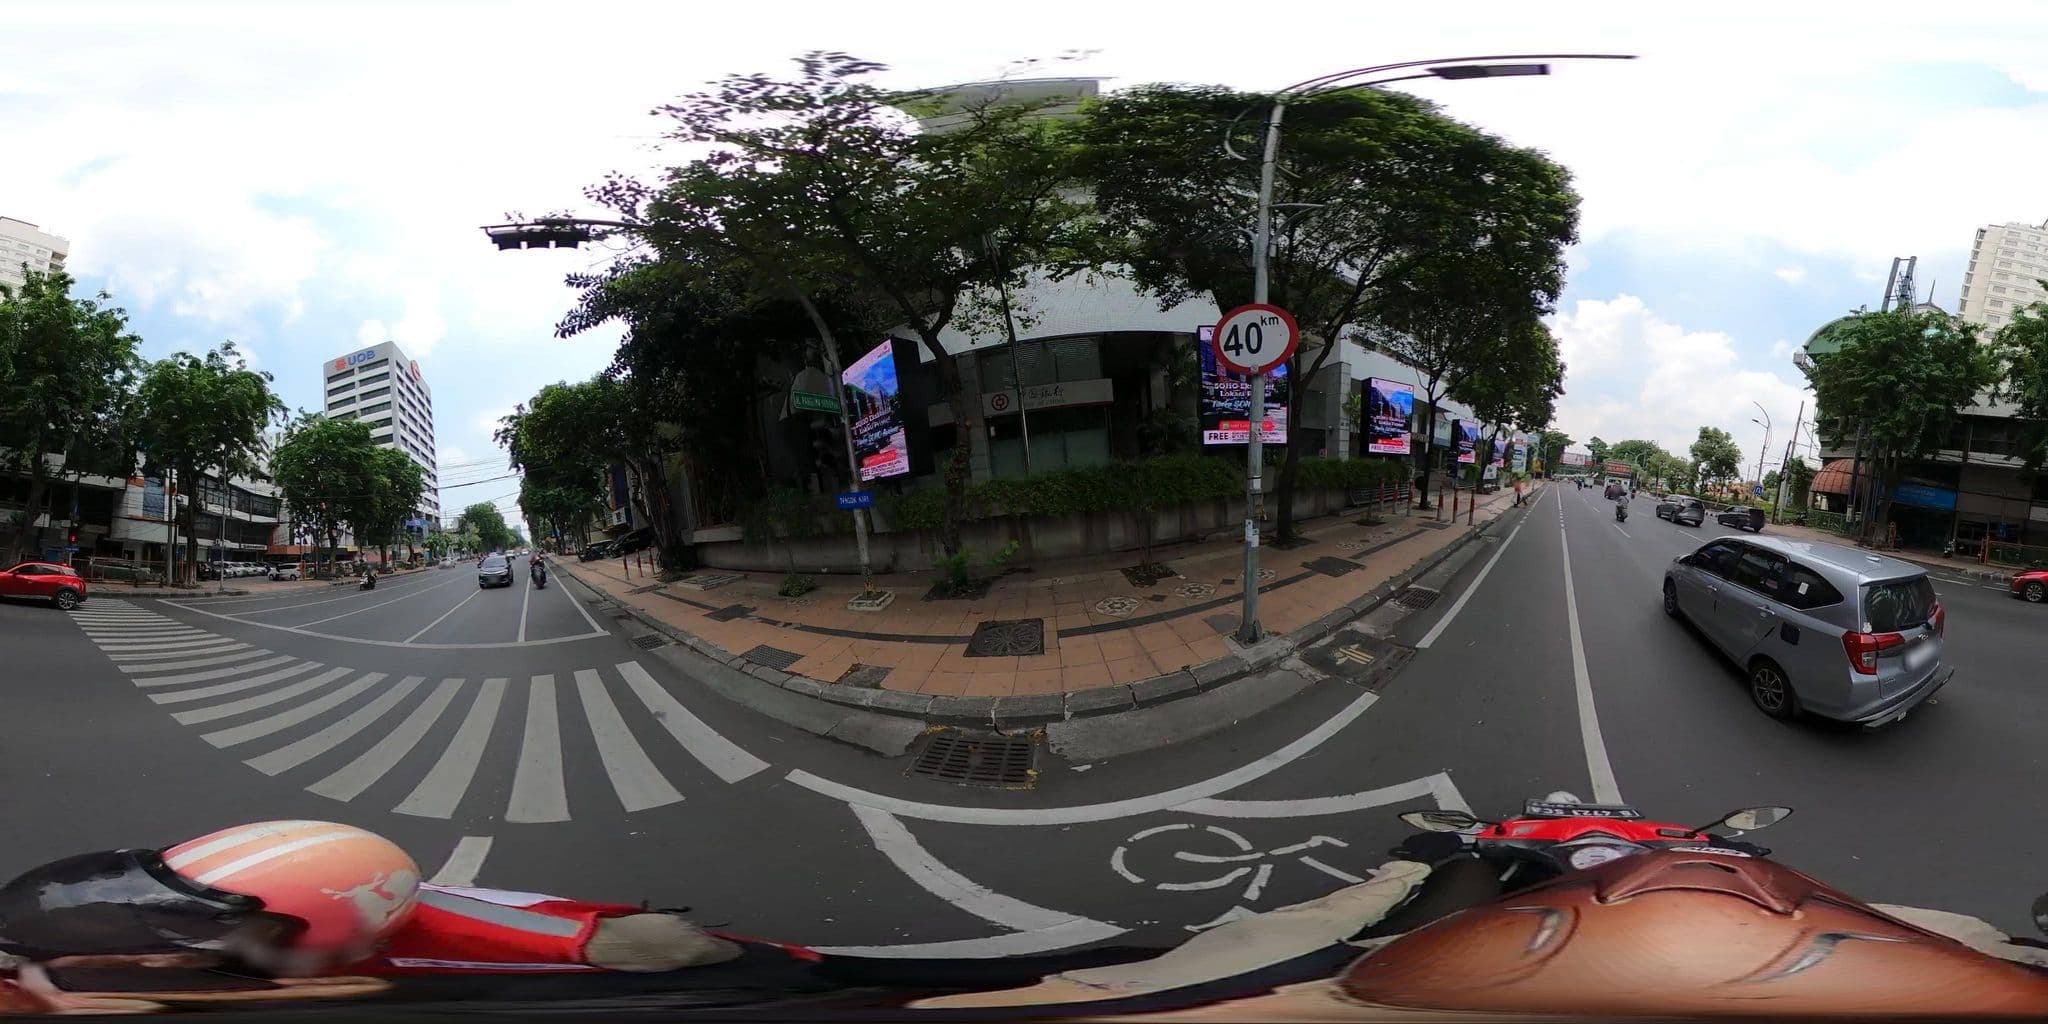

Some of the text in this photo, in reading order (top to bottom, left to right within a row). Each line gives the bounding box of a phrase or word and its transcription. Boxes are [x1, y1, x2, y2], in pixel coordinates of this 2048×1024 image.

[1223, 315, 1279, 356] 40 km
[348, 351, 375, 365] UOB
[1208, 432, 1229, 441] FREE
